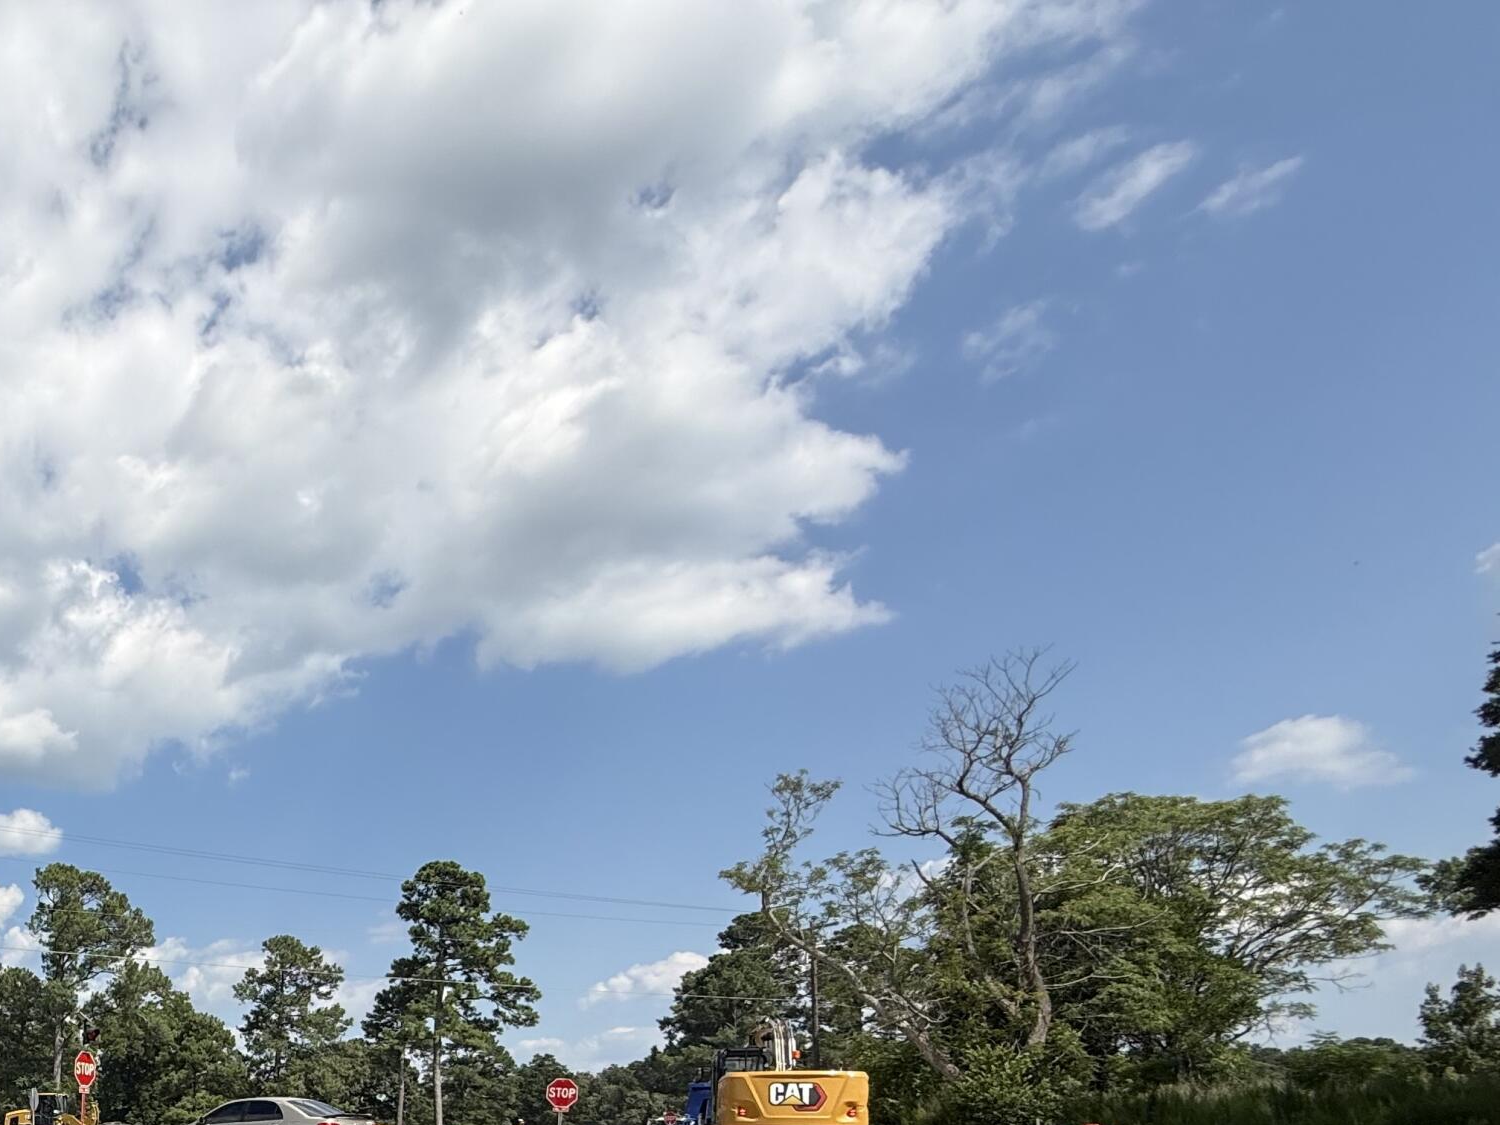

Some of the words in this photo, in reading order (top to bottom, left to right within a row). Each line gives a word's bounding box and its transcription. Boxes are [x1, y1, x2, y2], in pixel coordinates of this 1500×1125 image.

[76, 1062, 95, 1076] STOP
[548, 1087, 576, 1099] STOP
[769, 1083, 813, 1105] CAT
